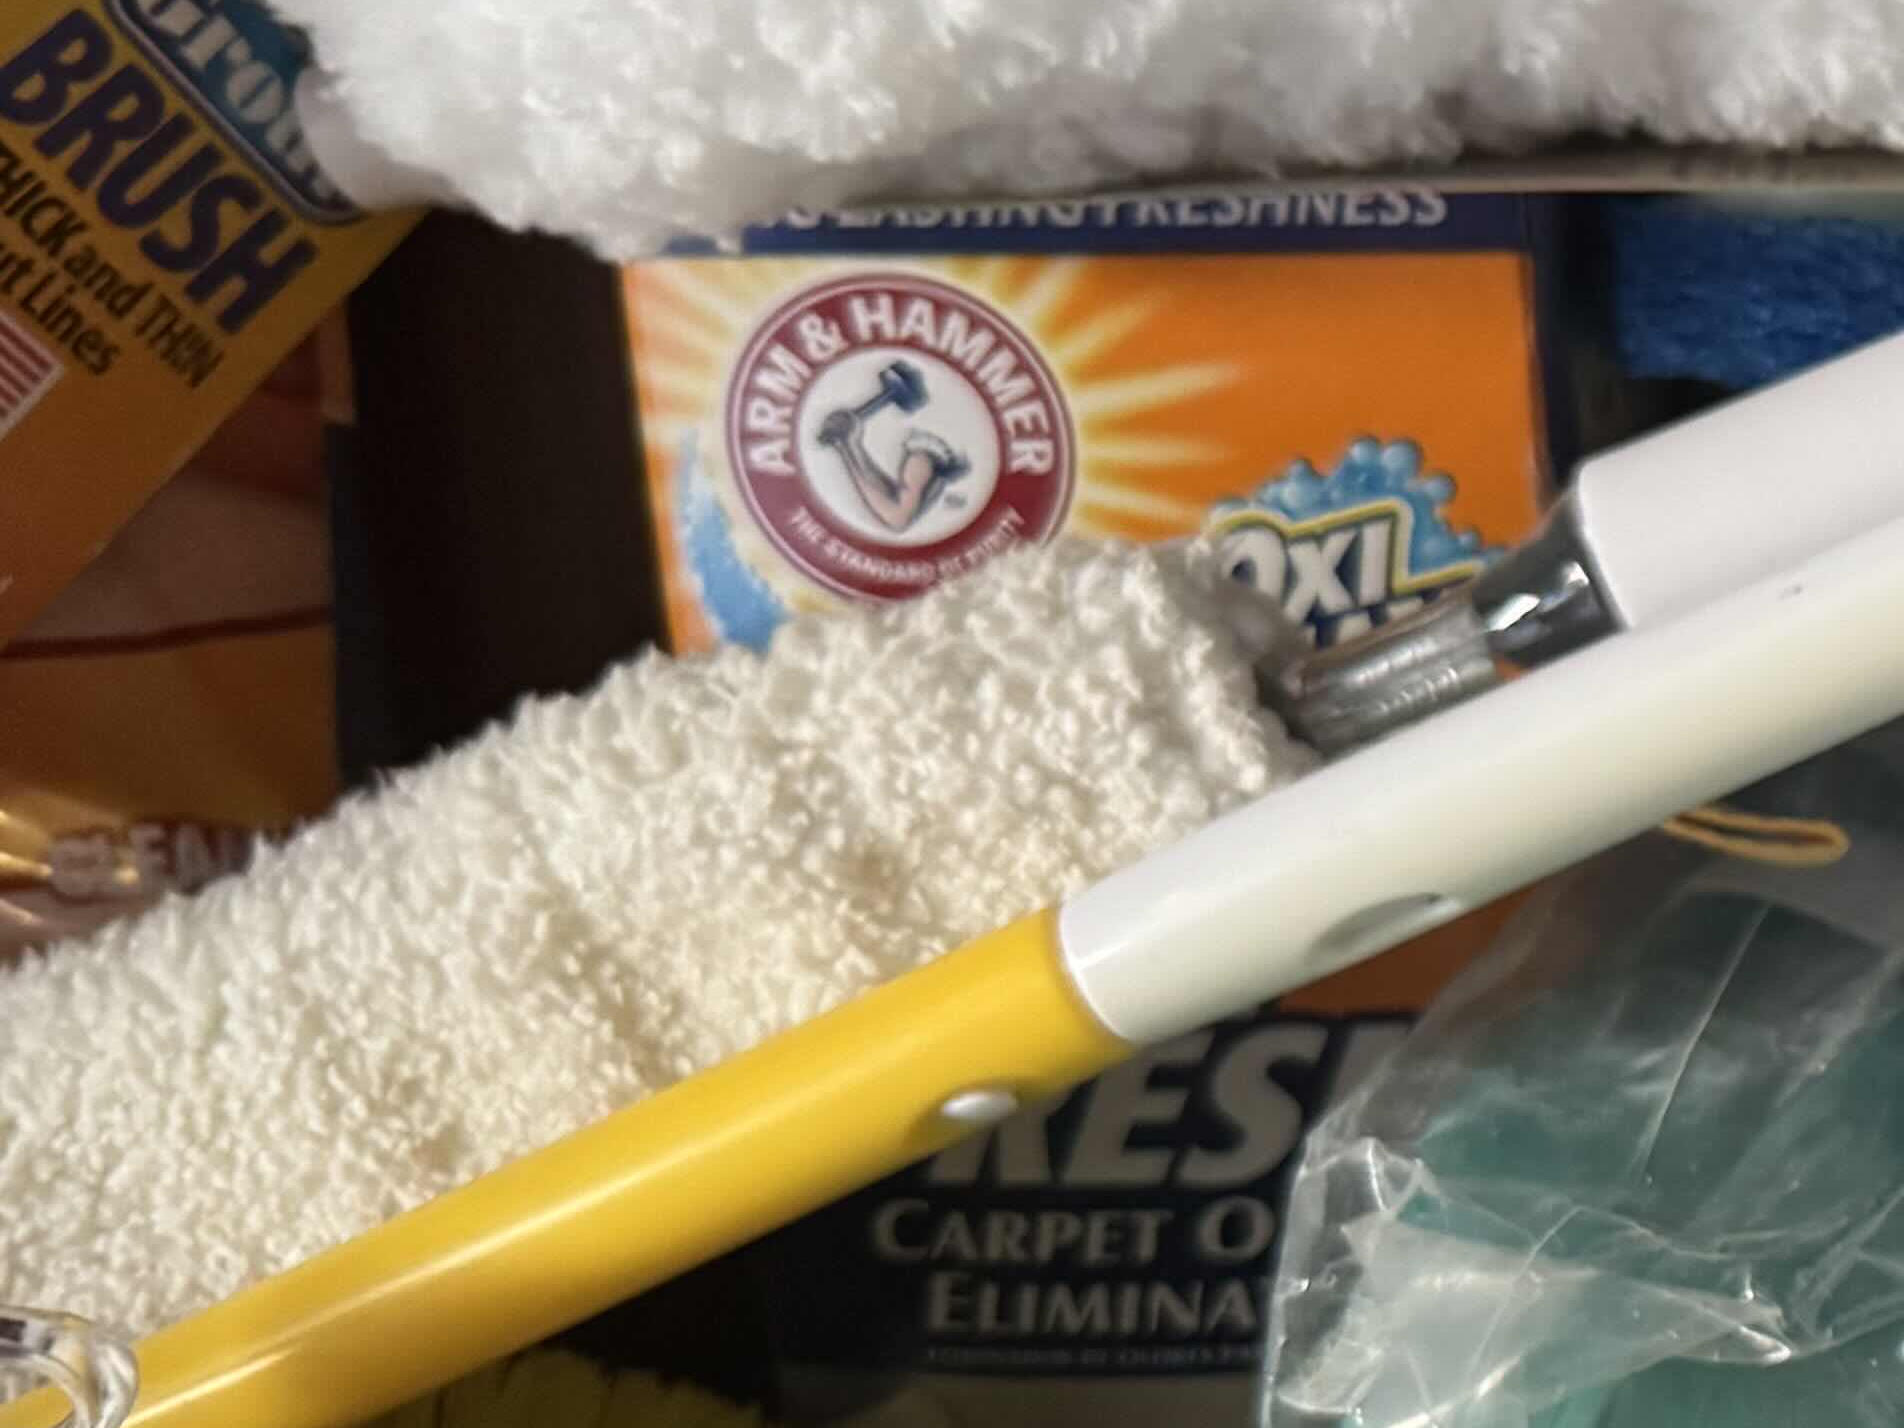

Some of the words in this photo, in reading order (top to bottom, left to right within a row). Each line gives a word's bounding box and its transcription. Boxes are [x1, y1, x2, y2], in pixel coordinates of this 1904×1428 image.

[0, 8, 317, 334] BRUSH
[64, 244, 154, 319] and
[746, 343, 806, 475] ARM
[799, 308, 850, 363] &
[848, 289, 1055, 477] HAMMER
[1222, 526, 1393, 623] OXI
[927, 1272, 1257, 1336] ELIMINA
